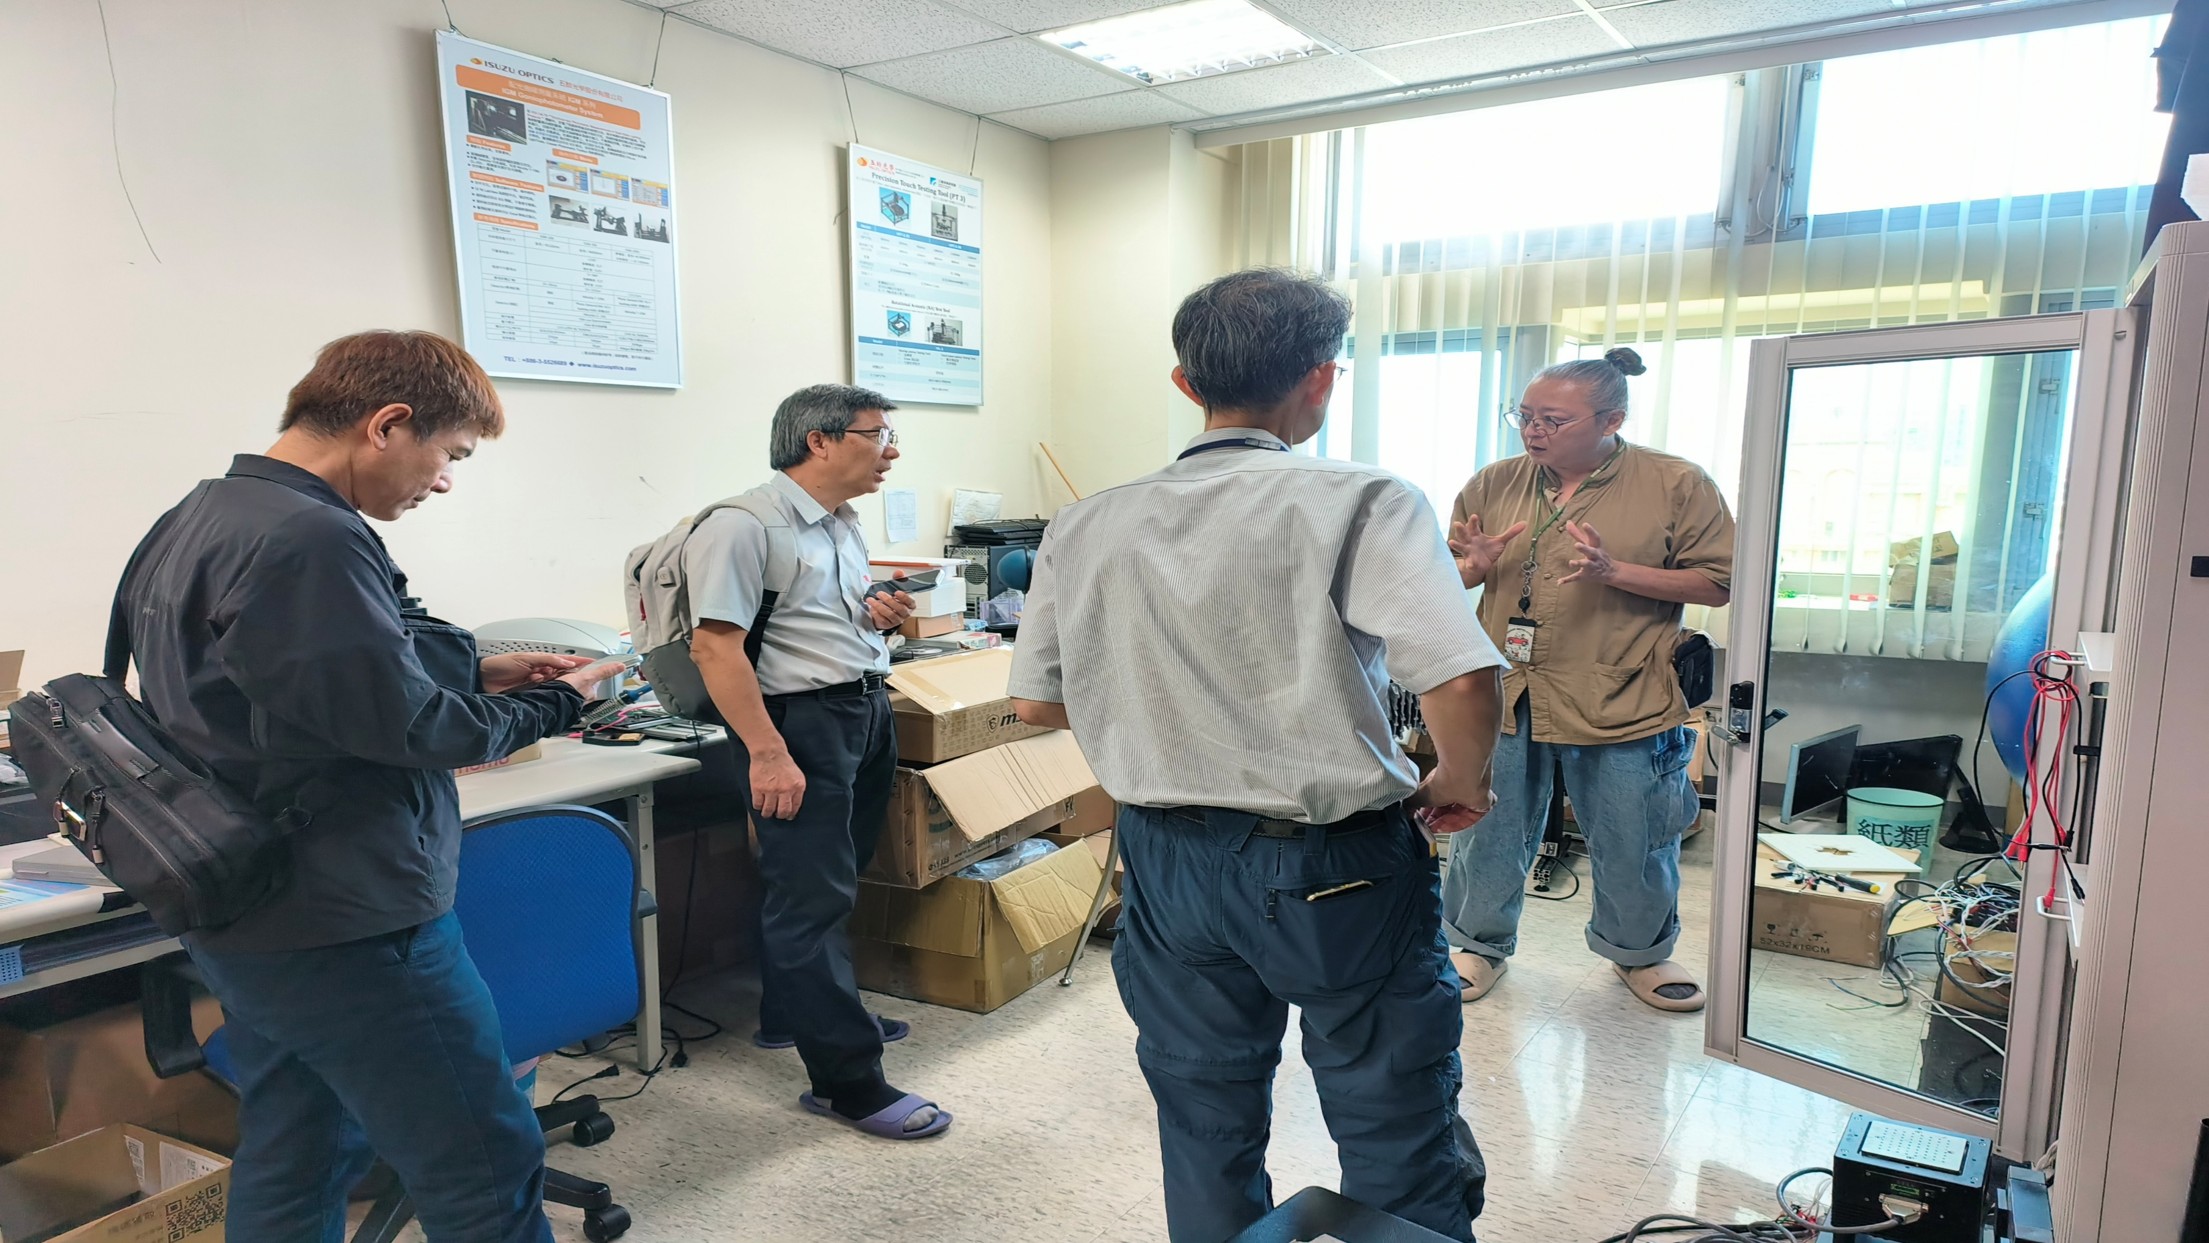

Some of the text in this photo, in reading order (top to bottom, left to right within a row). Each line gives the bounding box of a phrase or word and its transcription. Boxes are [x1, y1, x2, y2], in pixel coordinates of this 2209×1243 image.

[484, 61, 554, 84] ISUZU OPTICS
[872, 172, 899, 185] Precision
[900, 179, 917, 189] Touch
[918, 184, 937, 196] Testing
[938, 189, 949, 198] Tool
[1857, 818, 1932, 848] 紙類
